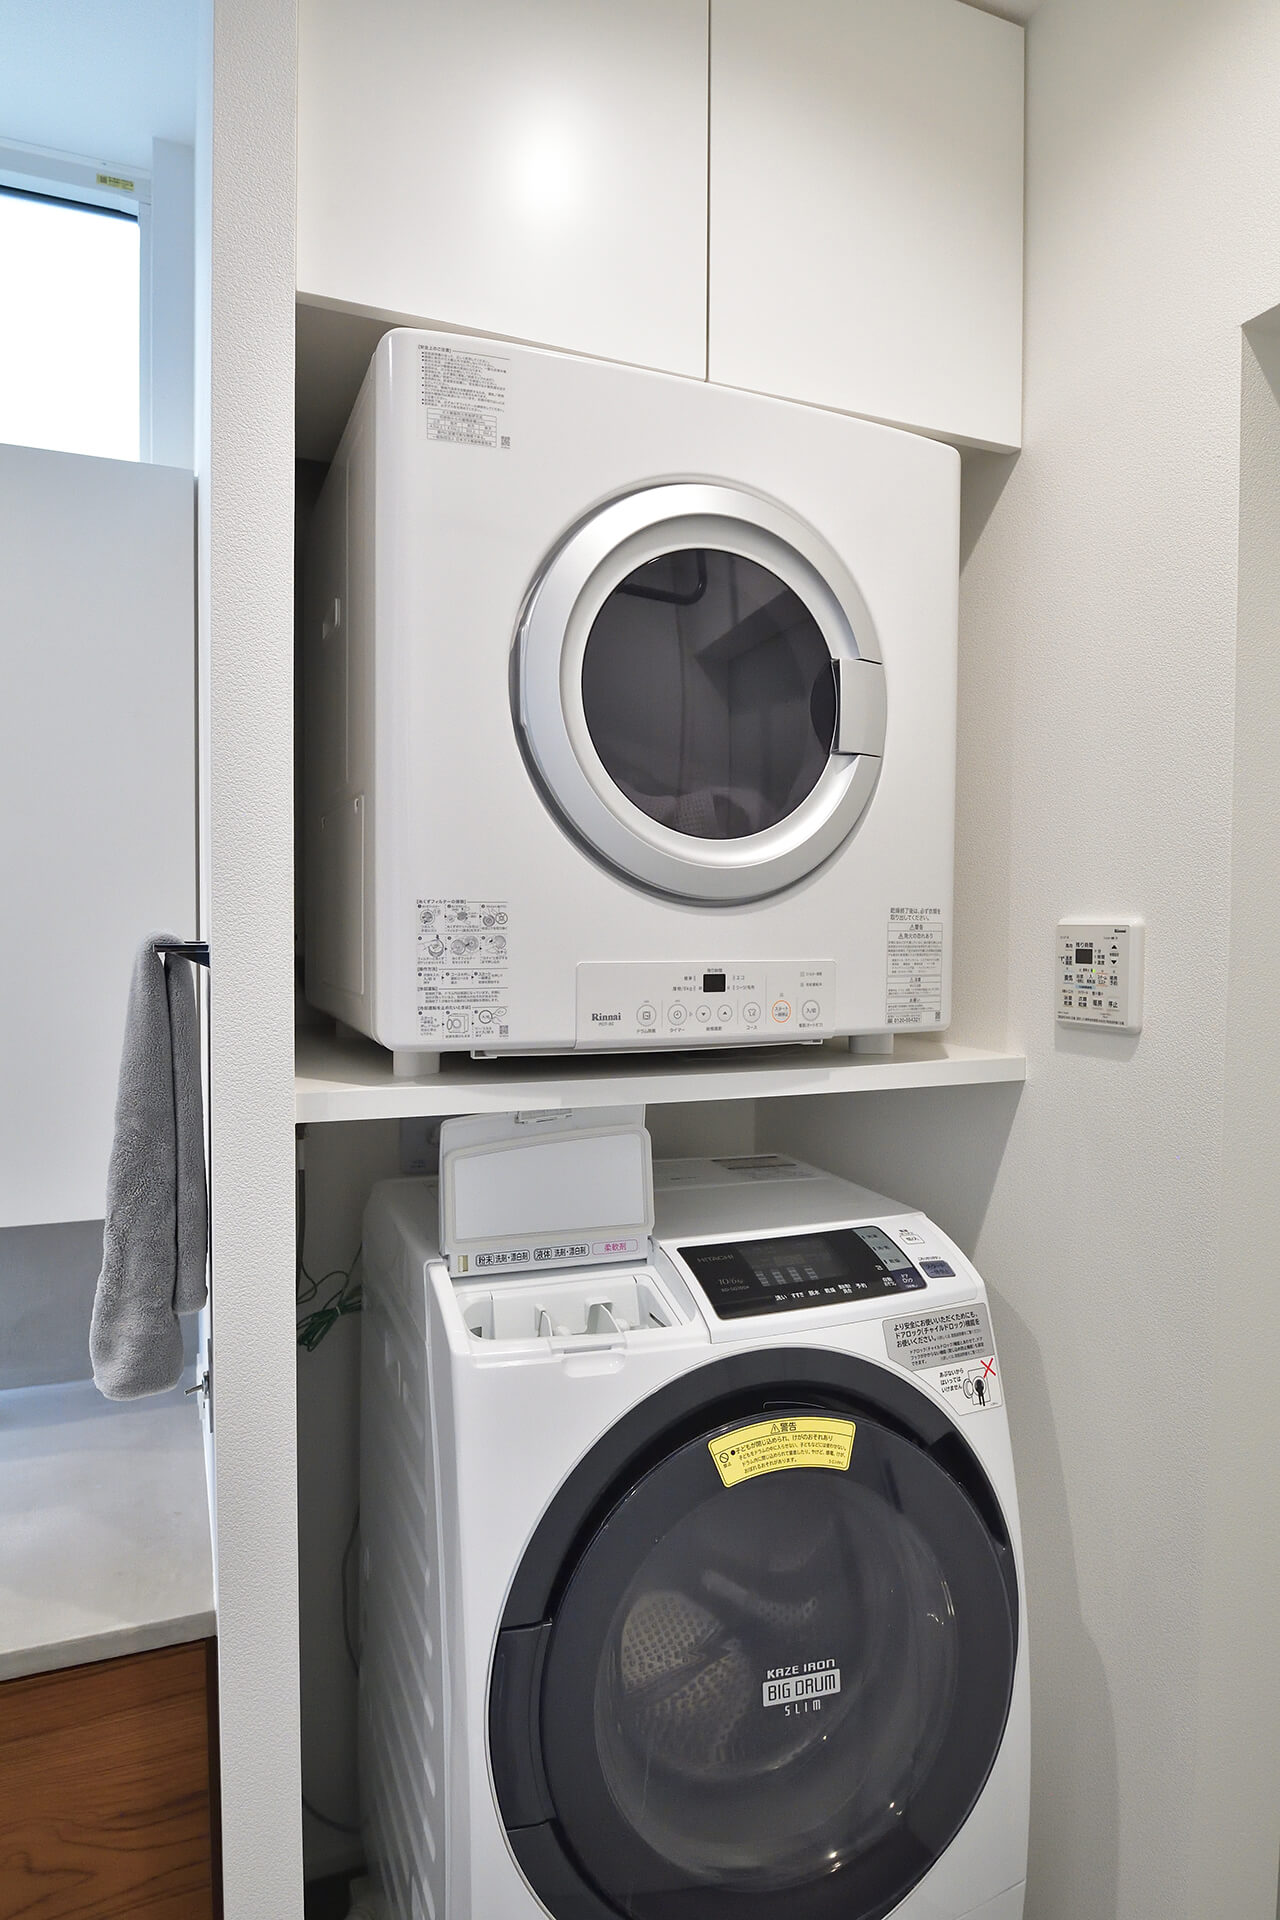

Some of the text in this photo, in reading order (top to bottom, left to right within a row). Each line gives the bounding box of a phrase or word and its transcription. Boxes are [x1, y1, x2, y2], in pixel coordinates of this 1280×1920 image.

[591, 1012, 621, 1021] Rinnai
[536, 1246, 587, 1260] 液体 洗剤・漂白剤
[604, 1242, 627, 1252] 柔軟剤
[478, 1252, 529, 1265] 粉末 洗剤・漂白剤
[893, 1311, 978, 1332] より安全にお使いいただくためにも、
[896, 1335, 937, 1348] お使いください。
[940, 1368, 964, 1378] あぶないから
[940, 1377, 961, 1386] はいっては
[941, 1384, 962, 1393] いけません
[780, 1422, 797, 1432] 警告
[767, 1659, 836, 1680] KAZE IRON
[768, 1674, 836, 1701] BIG DRUM
[784, 1700, 821, 1716] SLIM
